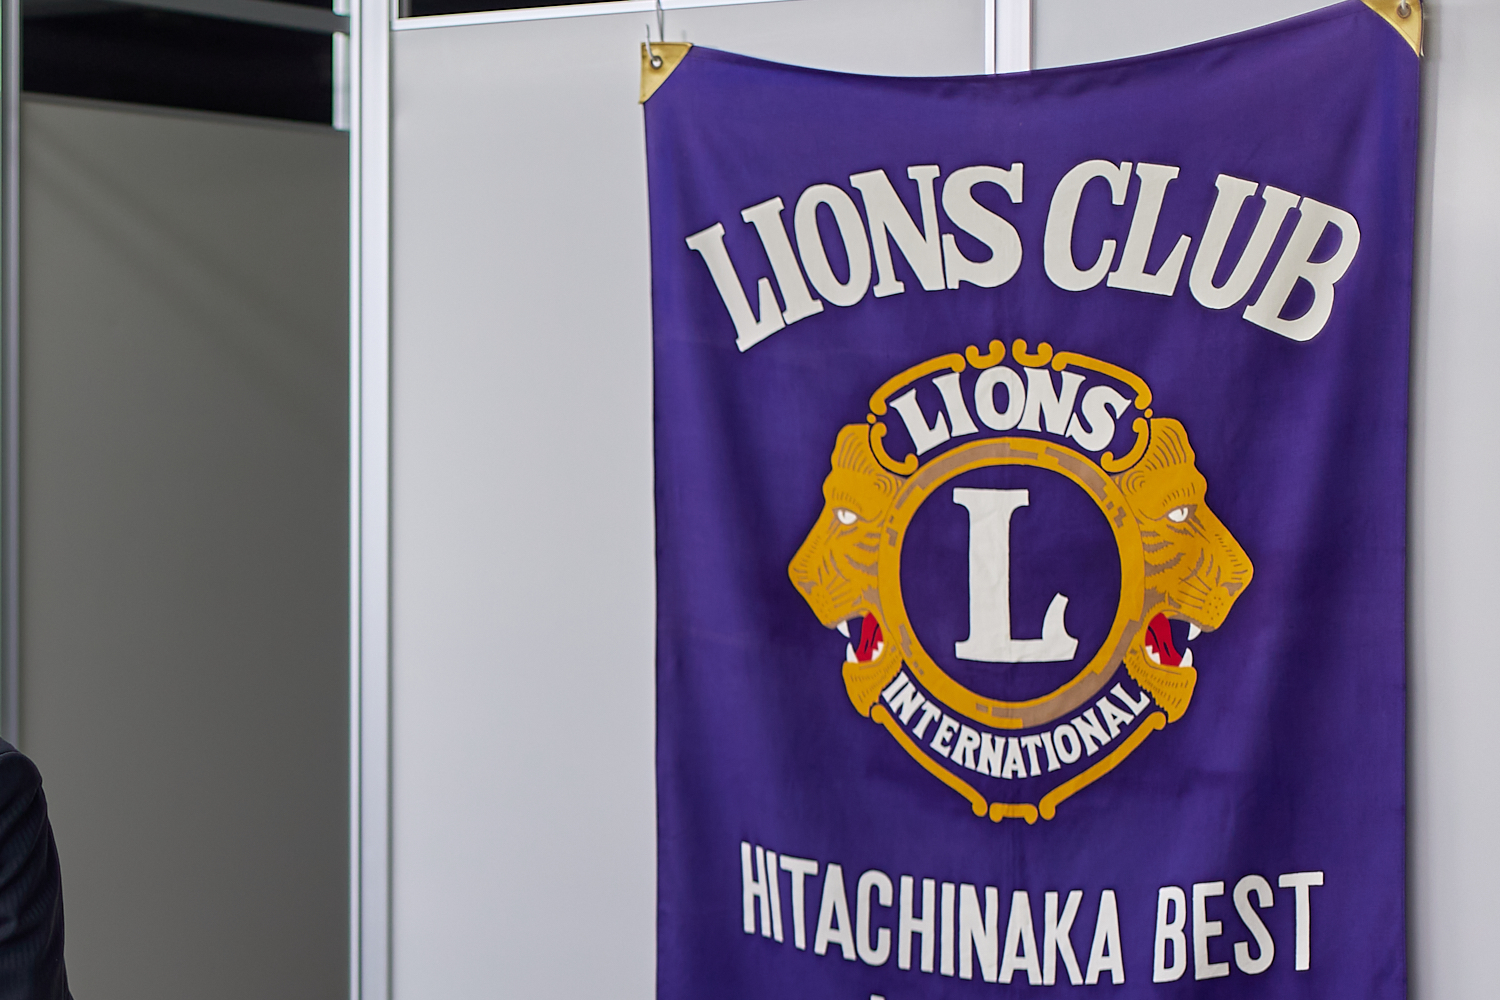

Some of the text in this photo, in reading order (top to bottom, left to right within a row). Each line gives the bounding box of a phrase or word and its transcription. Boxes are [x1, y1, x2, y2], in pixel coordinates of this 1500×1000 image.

[686, 160, 1361, 351] LIONS CLUB
[889, 366, 1132, 456] LIONS
[953, 487, 1079, 663] L
[881, 671, 1150, 780] INTERNATIONAL
[741, 842, 1324, 985] HITACHINAKA BEST
